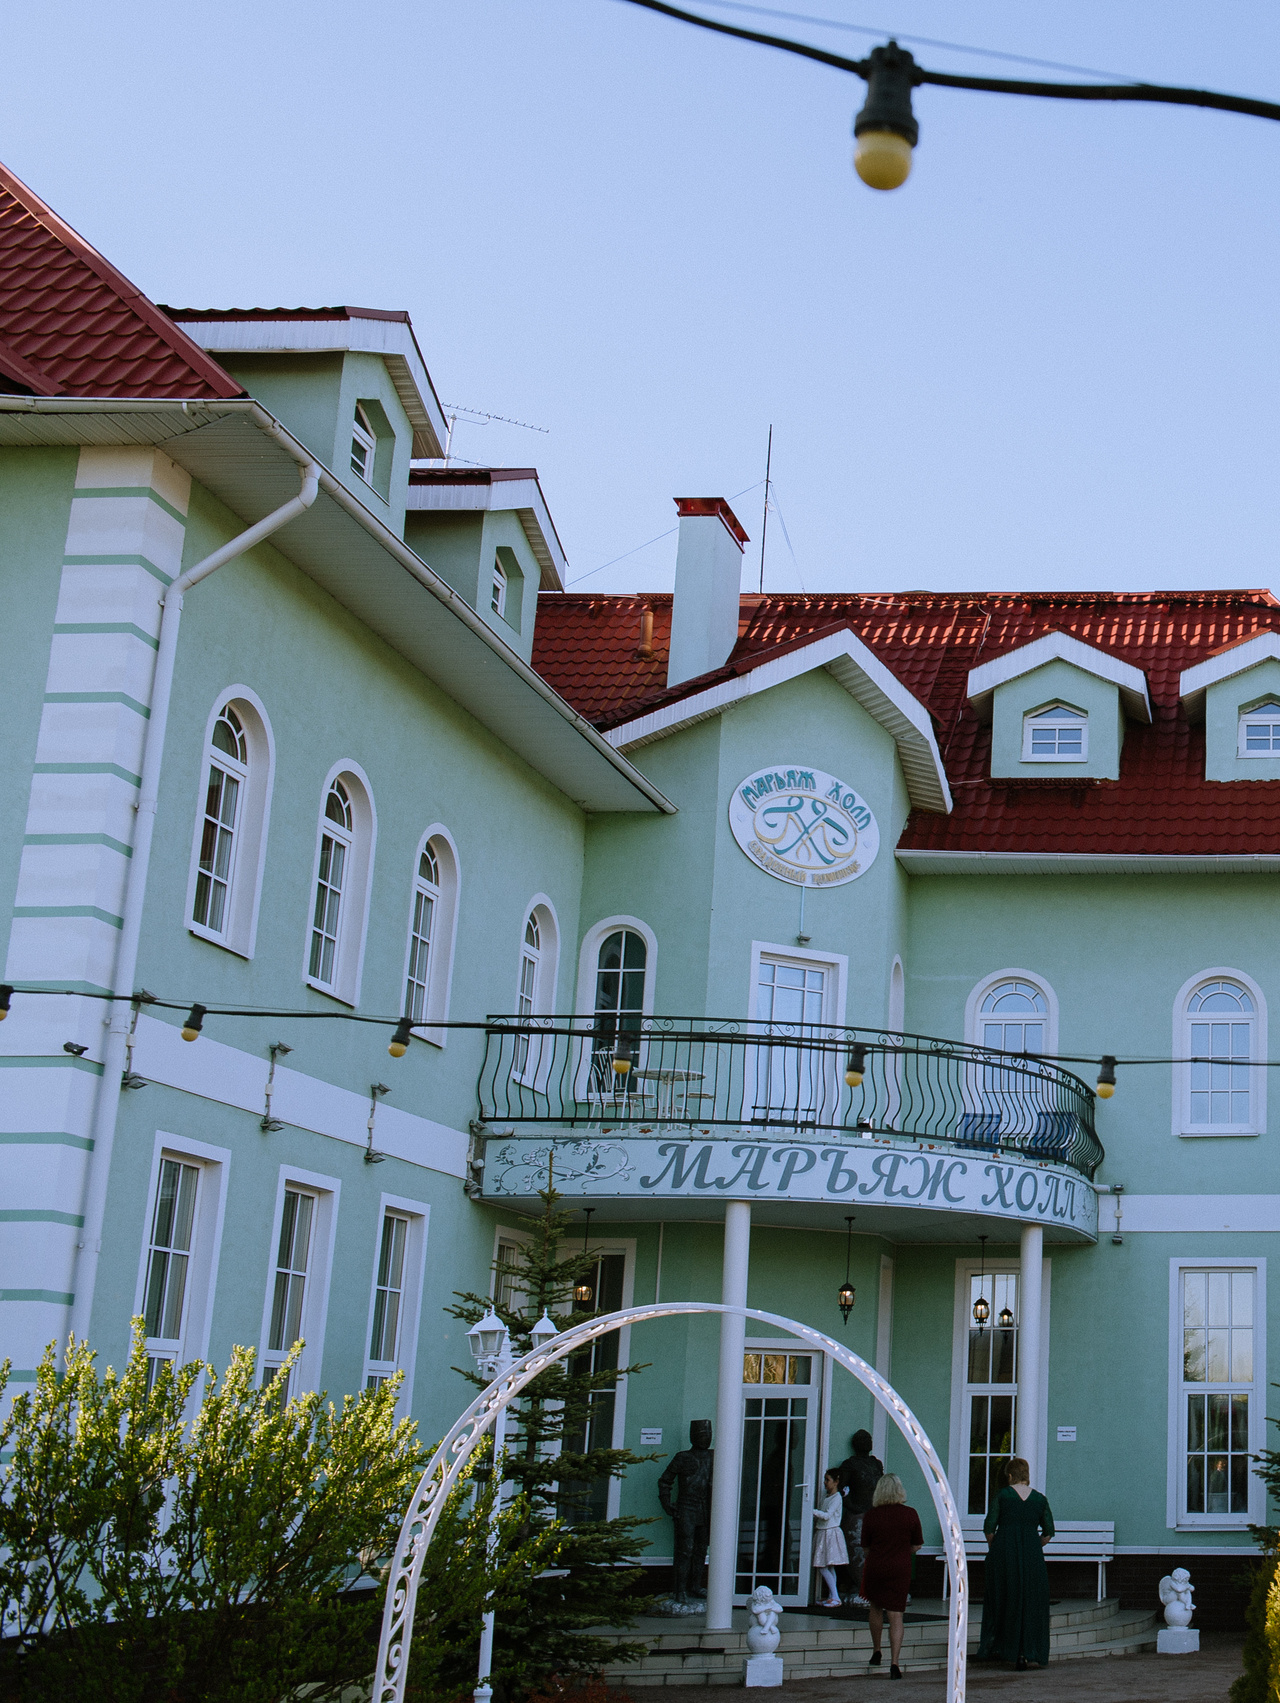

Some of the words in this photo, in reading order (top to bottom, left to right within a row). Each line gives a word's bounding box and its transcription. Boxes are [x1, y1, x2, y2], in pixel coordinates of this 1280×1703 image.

[741, 770, 817, 810] МАРЬЯЖ
[827, 781, 872, 831] ХОЛЛ
[981, 1164, 1076, 1222] ХОЛЛ
